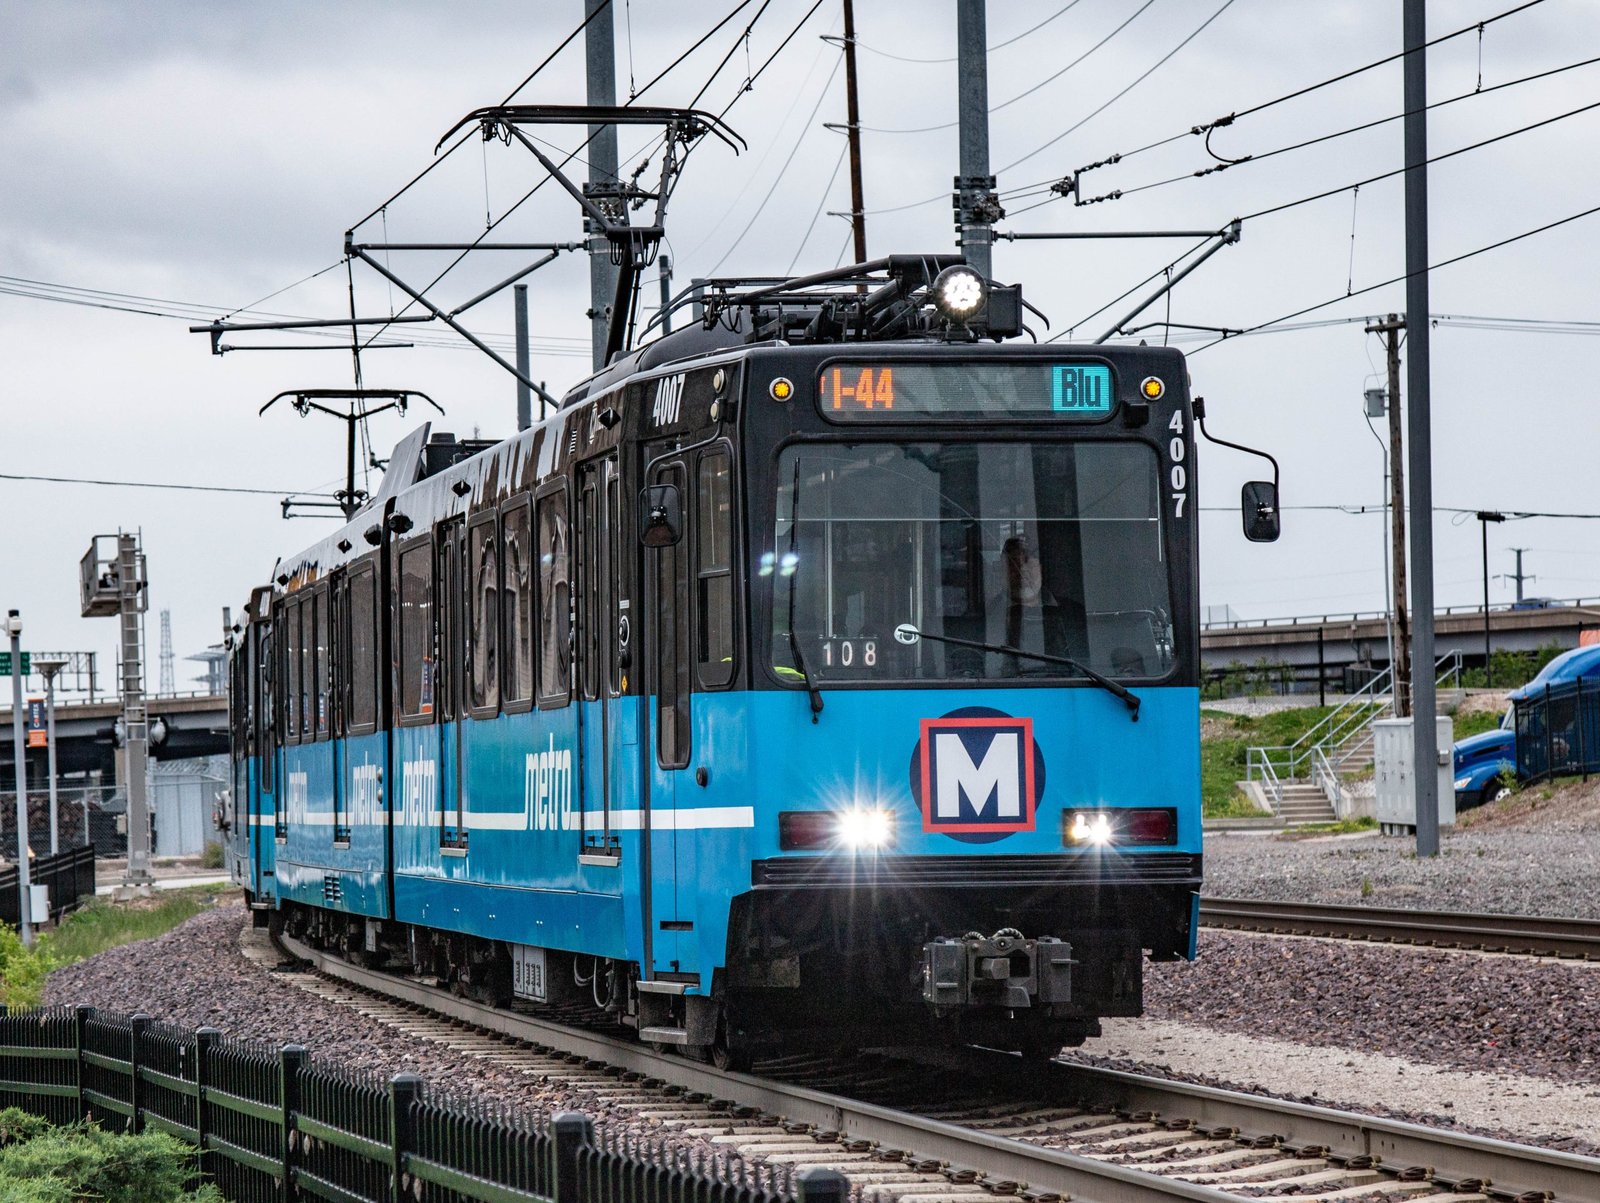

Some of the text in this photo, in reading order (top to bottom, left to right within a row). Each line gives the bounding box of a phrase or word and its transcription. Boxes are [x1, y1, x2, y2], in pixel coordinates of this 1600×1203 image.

[653, 373, 686, 427] 4007
[833, 368, 894, 409] I-44
[1061, 369, 1101, 408] Blu
[1169, 410, 1186, 518] 4007
[352, 751, 377, 825] metro
[403, 745, 435, 826] metro
[524, 732, 571, 830] metro
[936, 733, 1020, 817] M
